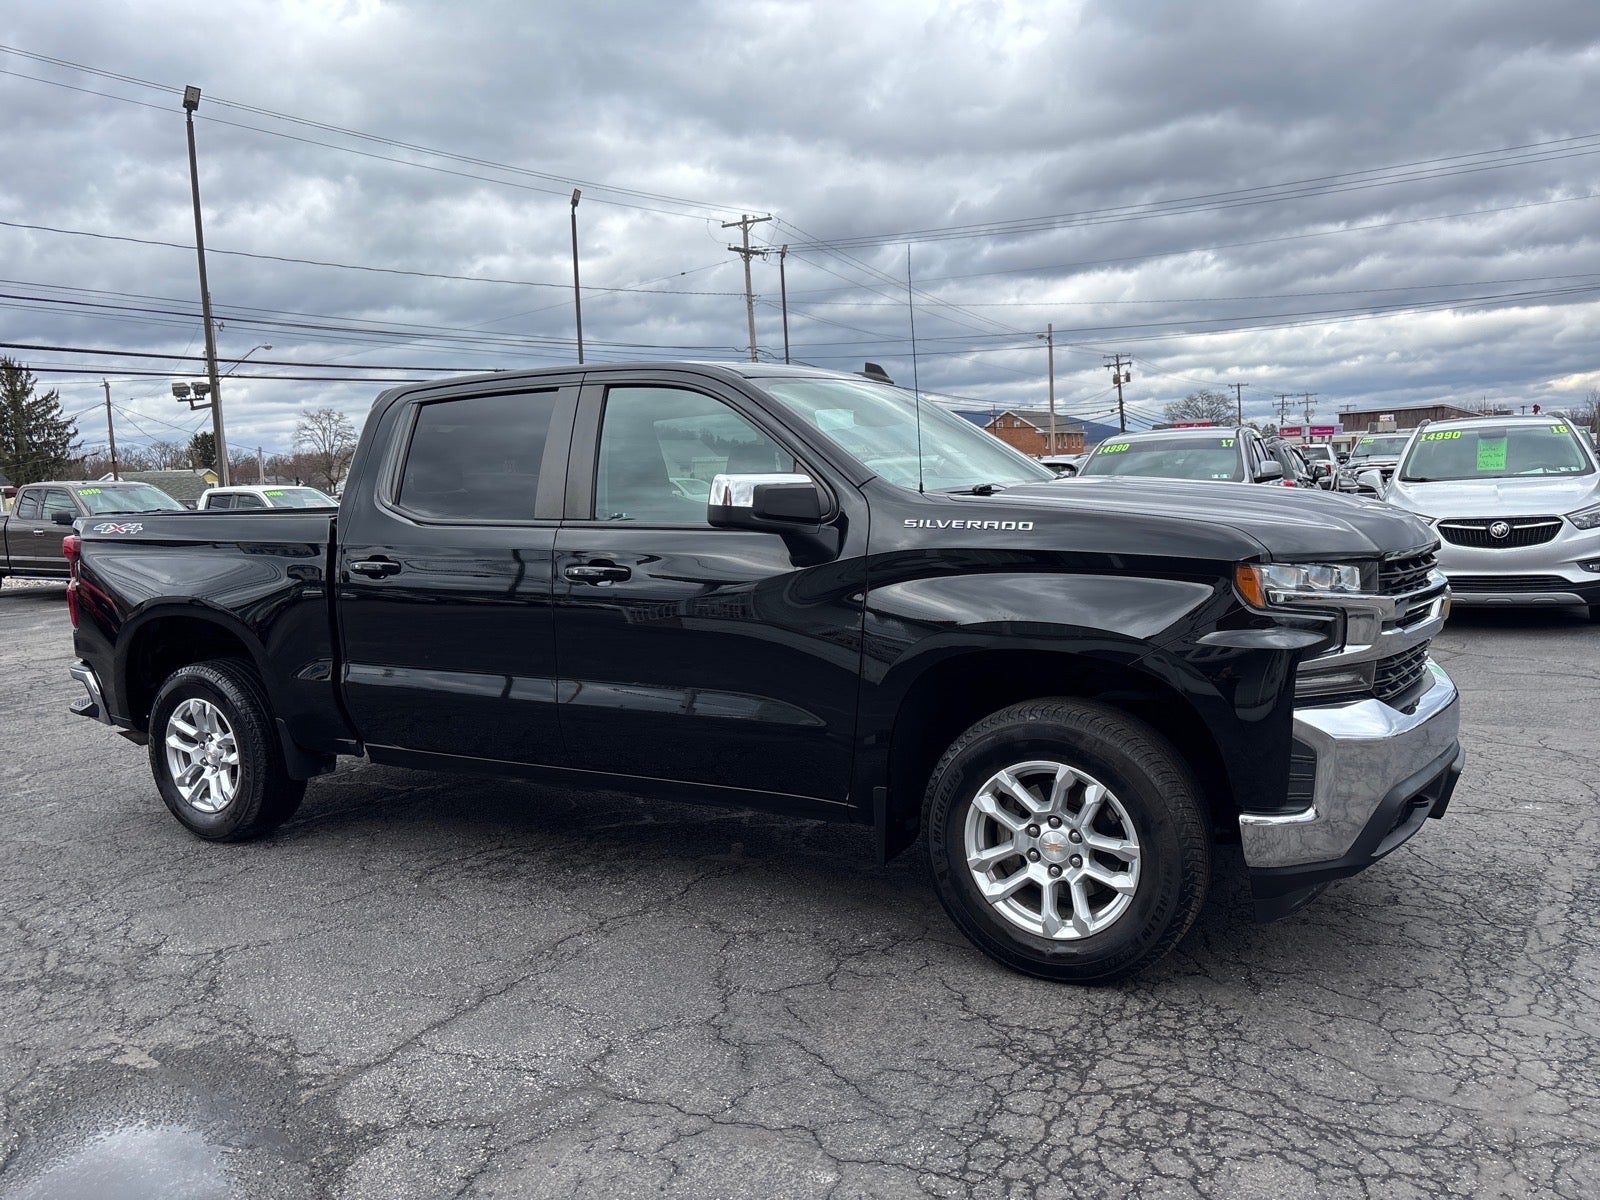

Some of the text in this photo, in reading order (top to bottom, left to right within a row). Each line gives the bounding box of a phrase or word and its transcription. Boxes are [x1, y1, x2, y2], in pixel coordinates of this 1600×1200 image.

[1419, 430, 1461, 442] 14990
[1097, 443, 1130, 455] 14990
[1221, 439, 1234, 447] 17
[903, 519, 1034, 531] SILVERADO
[933, 768, 962, 845] MICHELIN
